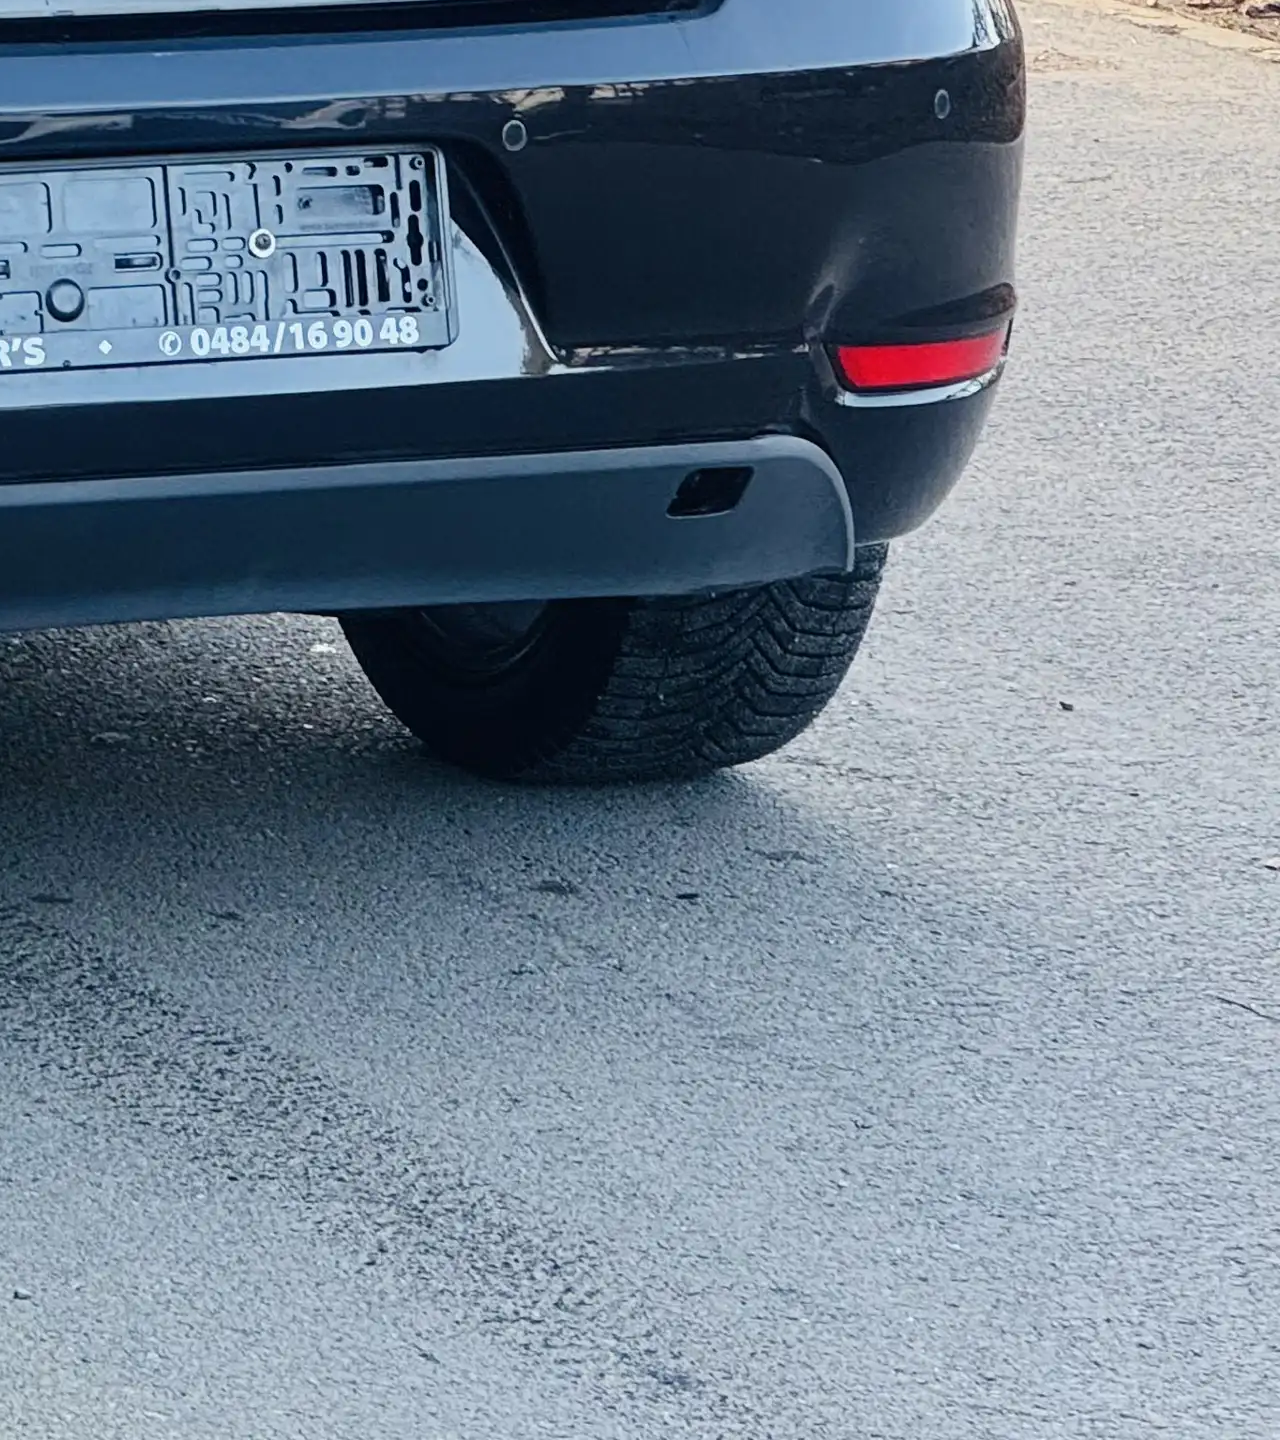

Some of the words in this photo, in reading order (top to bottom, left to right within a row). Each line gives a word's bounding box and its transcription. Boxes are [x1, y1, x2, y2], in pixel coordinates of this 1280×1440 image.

[190, 321, 328, 357] 0484/16
[332, 318, 373, 348] 90
[379, 315, 420, 345] 48
